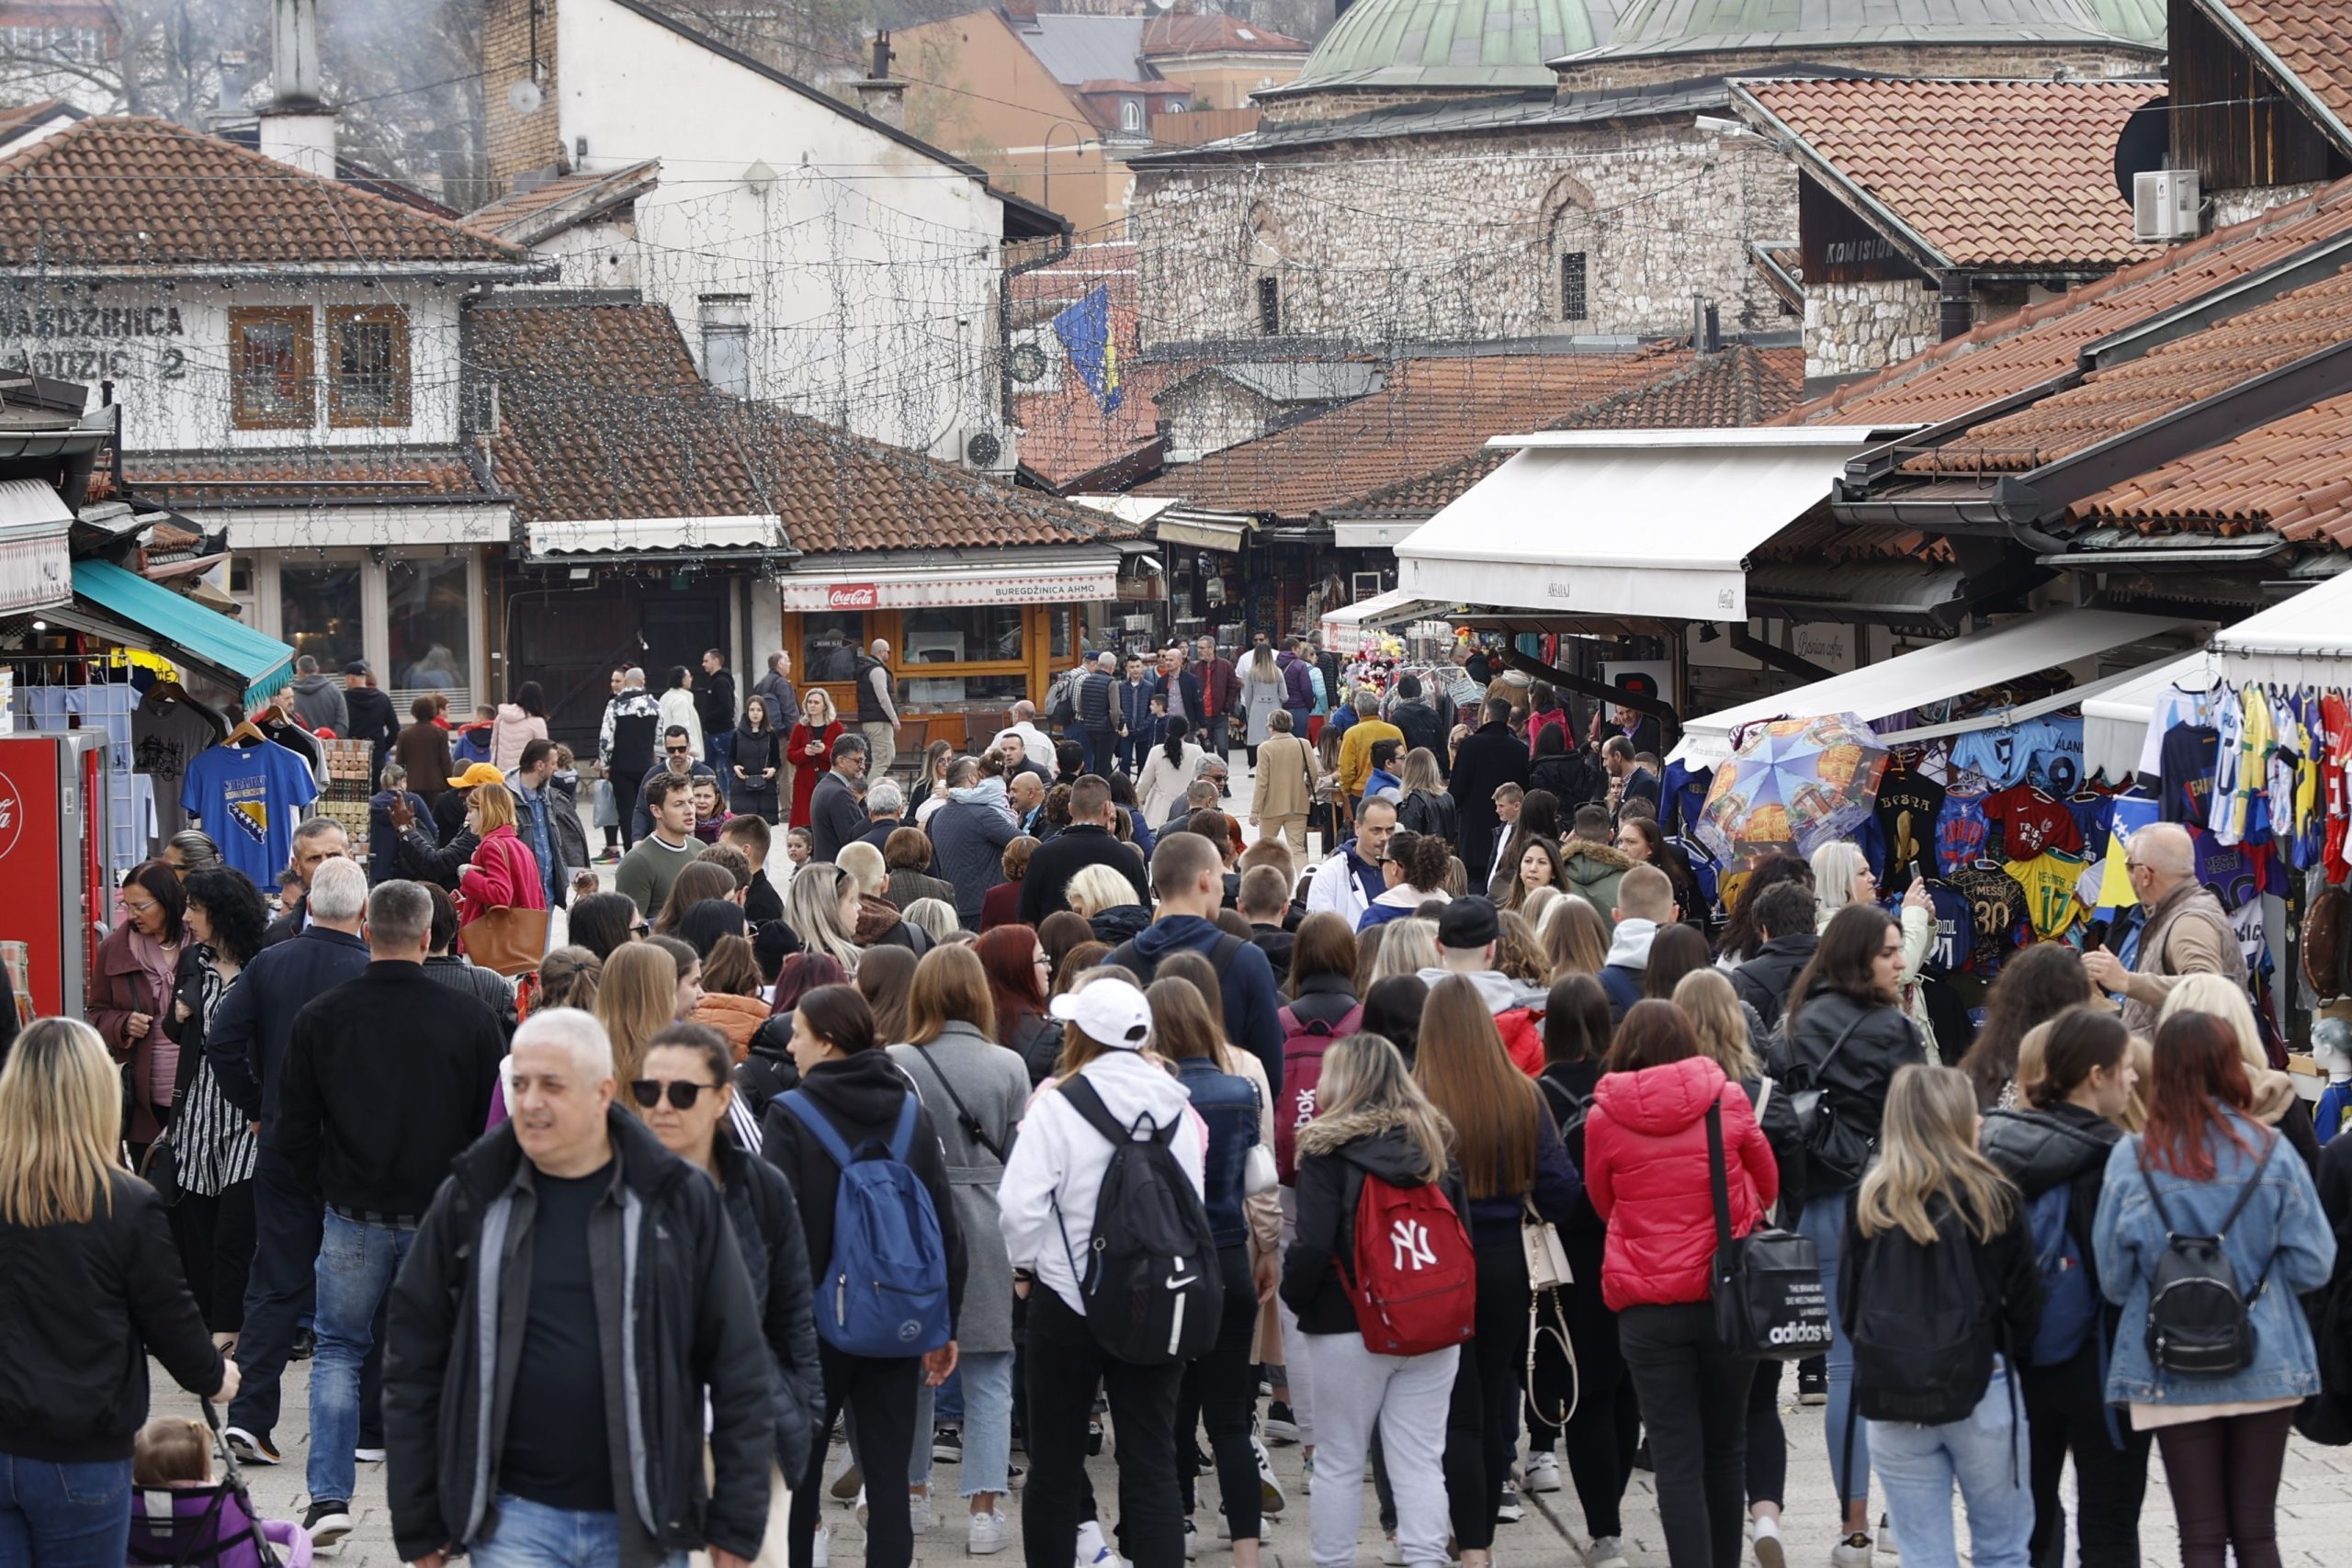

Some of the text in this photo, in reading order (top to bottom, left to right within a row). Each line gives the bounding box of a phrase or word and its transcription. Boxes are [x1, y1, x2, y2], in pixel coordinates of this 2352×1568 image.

[164, 348, 186, 378] 2
[830, 589, 874, 606] Coca-Cola
[995, 586, 1065, 596] BUREGDŽINICA
[1976, 885, 2007, 897] MESSI
[1974, 900, 2010, 936] 30
[1389, 1218, 1438, 1271] NY
[1769, 1320, 1822, 1344] adidas
